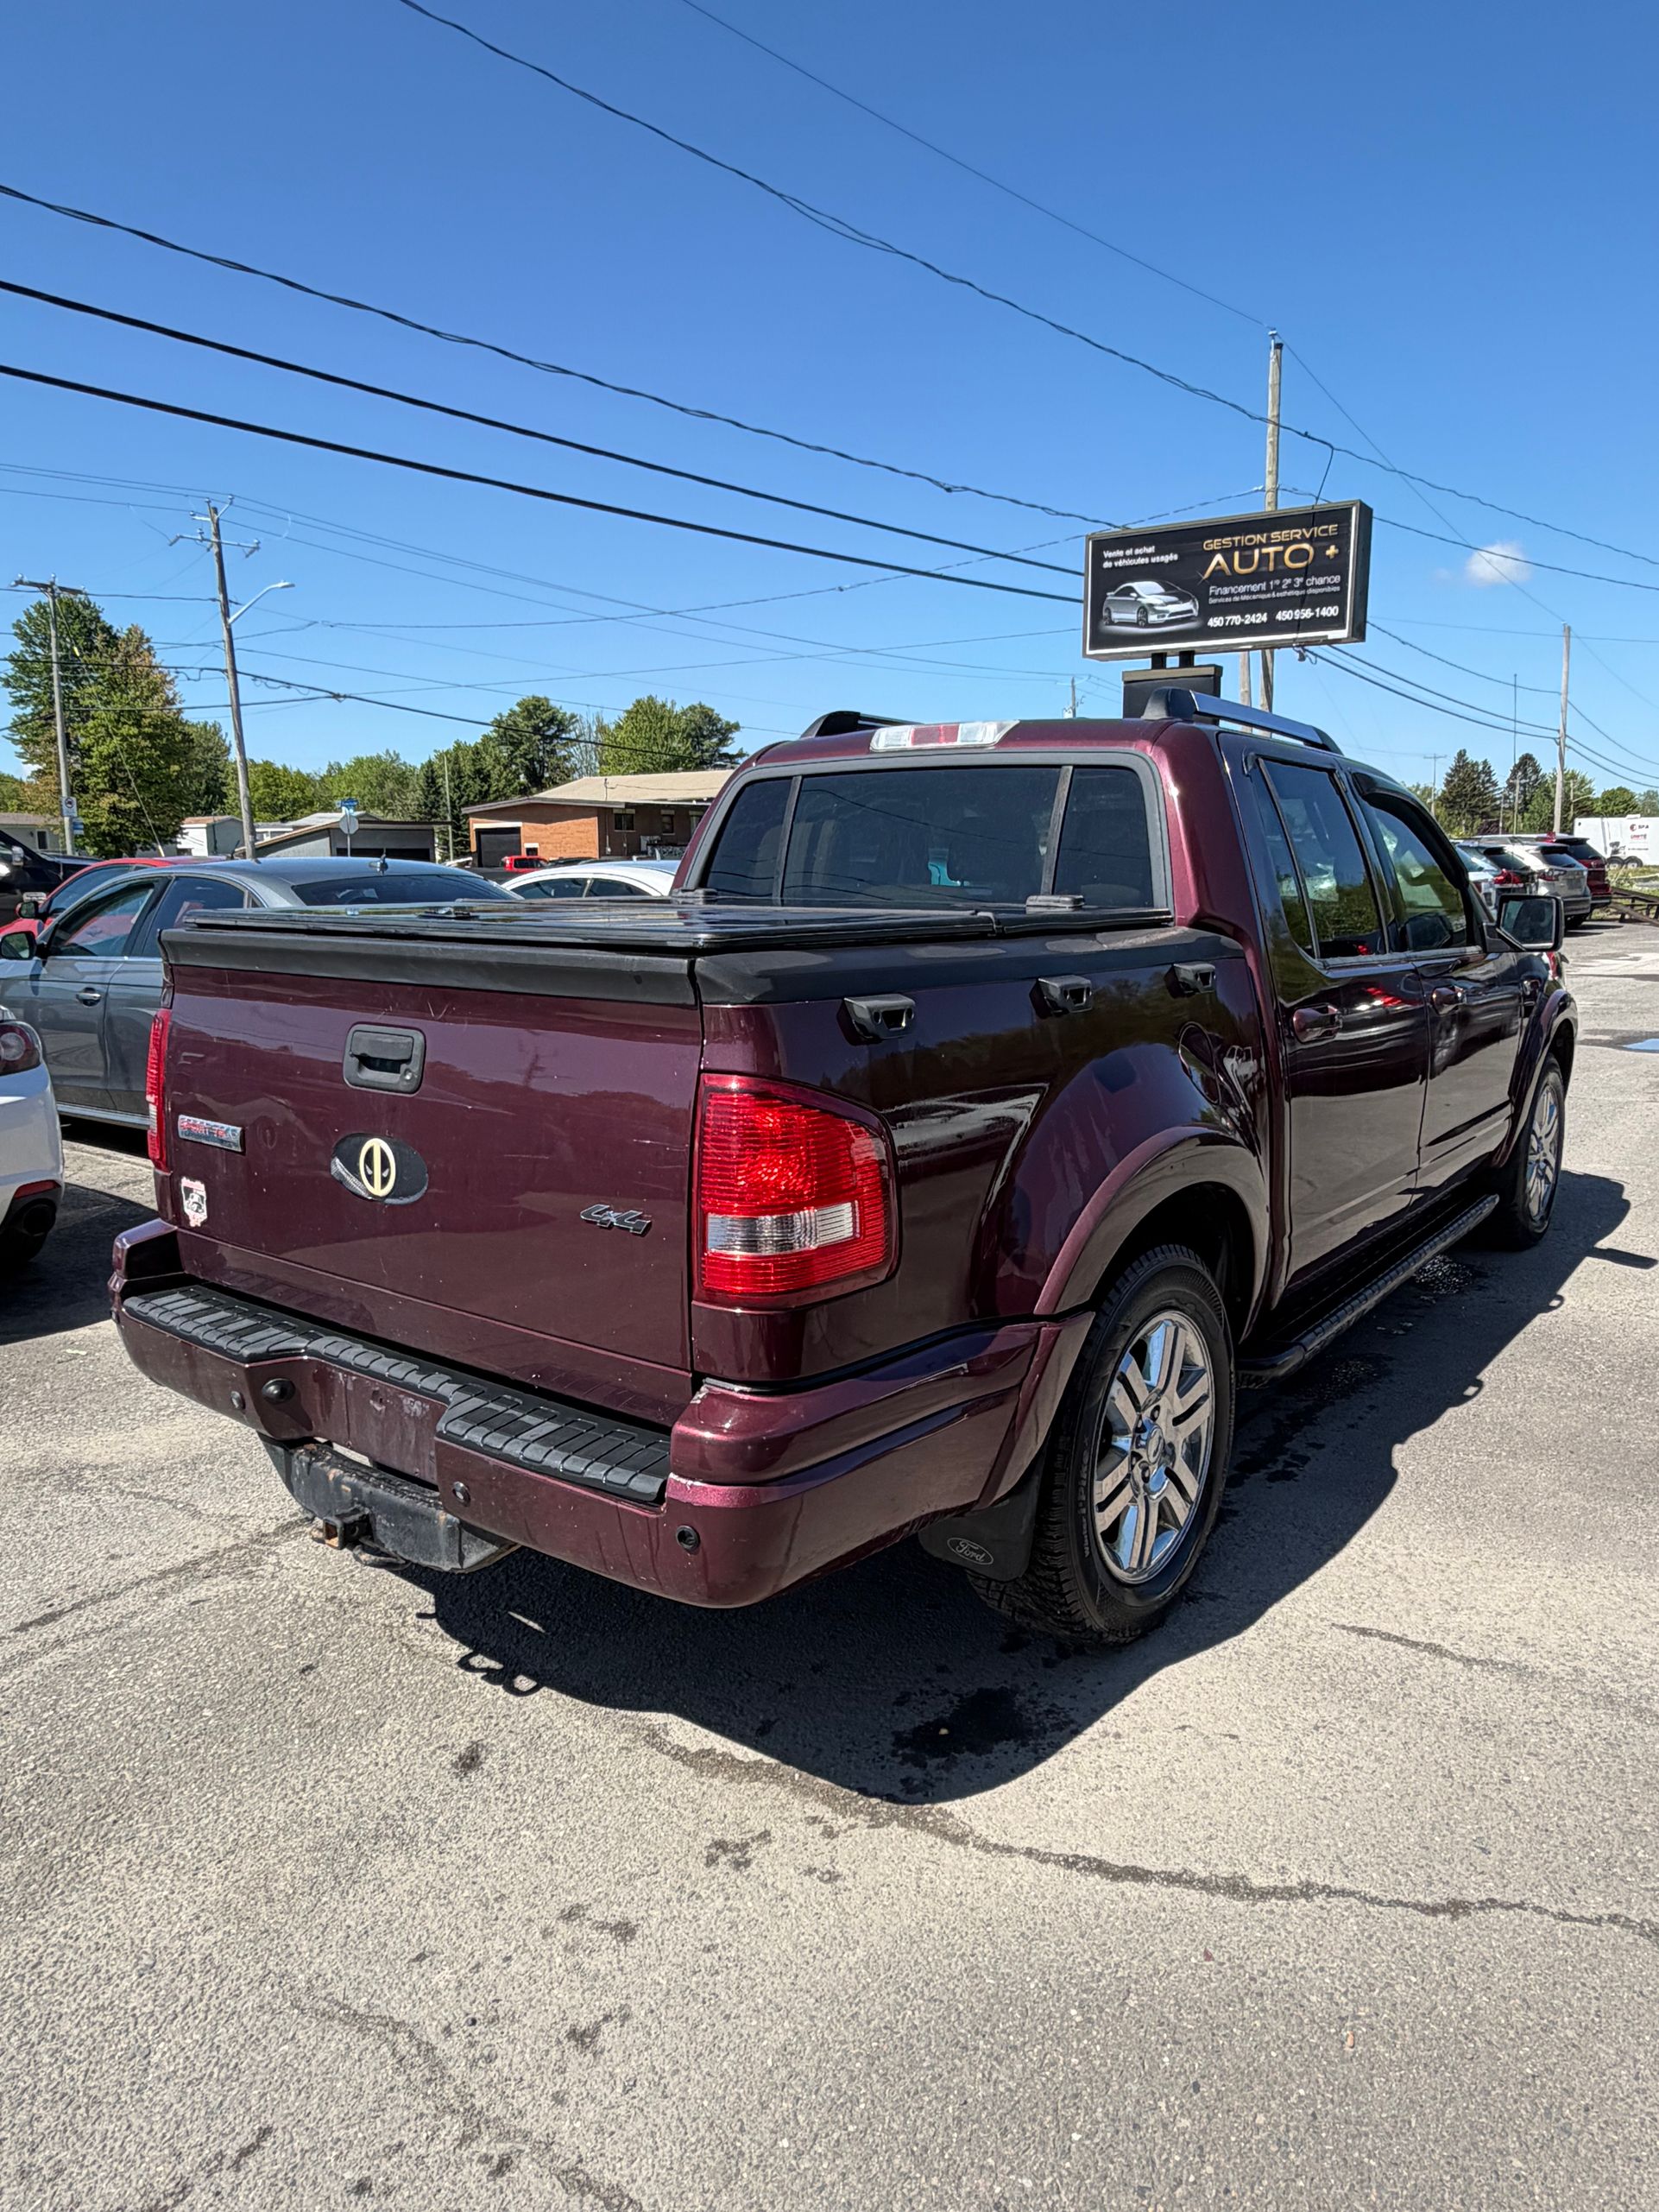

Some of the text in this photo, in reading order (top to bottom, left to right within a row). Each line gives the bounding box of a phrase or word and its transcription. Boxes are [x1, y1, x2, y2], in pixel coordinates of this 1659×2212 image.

[1203, 524, 1338, 551] GESTION SERVICE
[1202, 543, 1315, 580] AUTO
[1209, 582, 1266, 596] Financement
[1306, 575, 1340, 586] chance
[1208, 605, 1339, 627] 450 770-2424 450 956-1400
[956, 1540, 986, 1563] Ford
